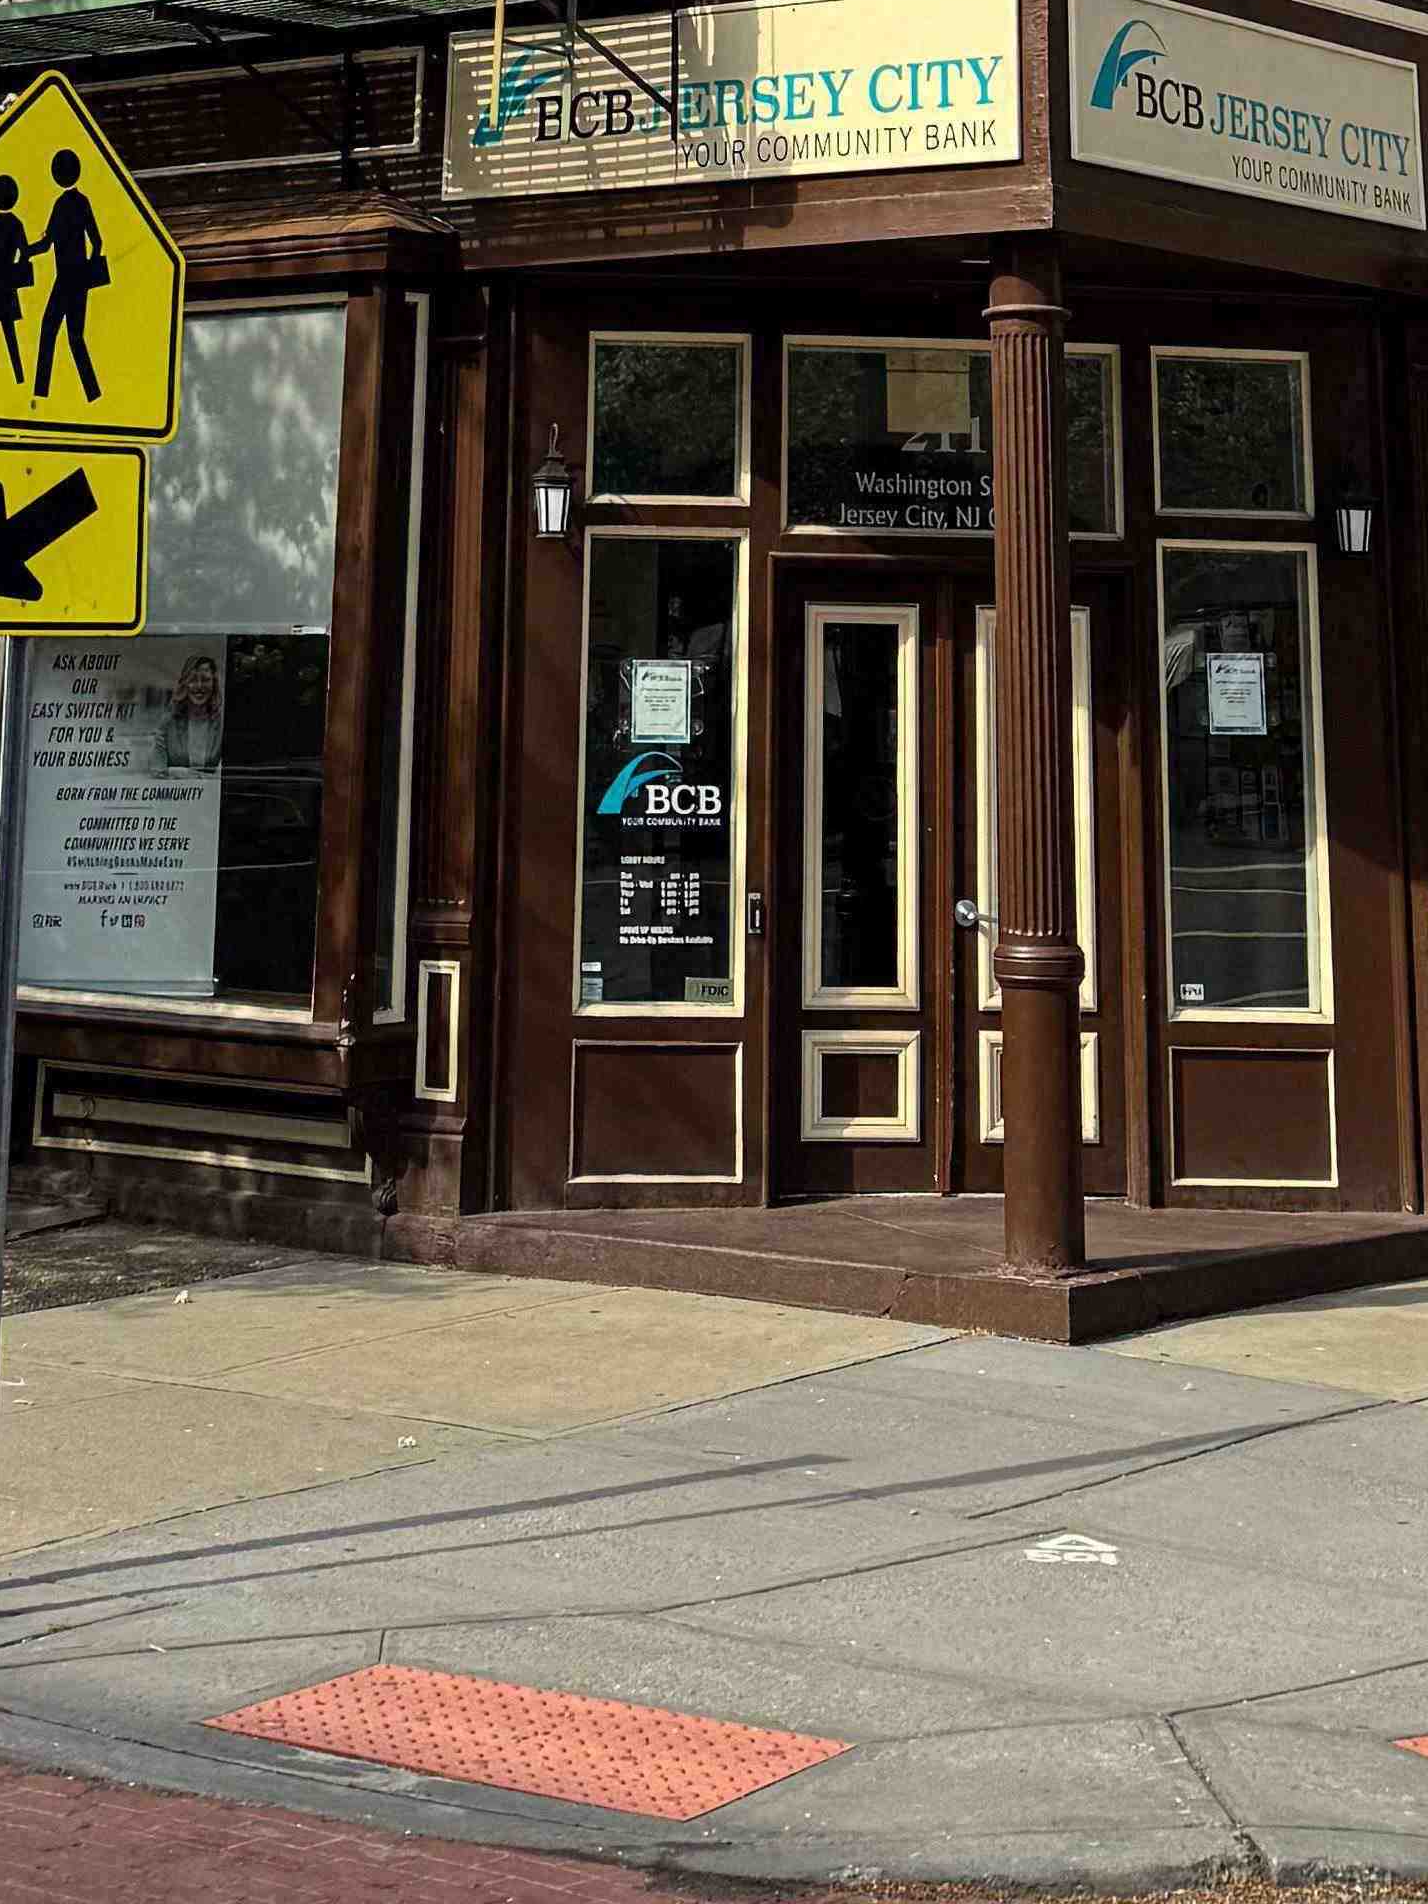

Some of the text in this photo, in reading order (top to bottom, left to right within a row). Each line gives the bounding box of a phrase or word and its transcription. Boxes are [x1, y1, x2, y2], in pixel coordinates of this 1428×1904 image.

[535, 55, 1003, 142] BCB JERSEY CITY
[1134, 72, 1411, 177] BCB JERSEY CITY
[681, 119, 997, 168] YOUR COMMUNITY BANK
[1231, 155, 1412, 216] YOUR COMMUNITY BANK
[855, 471, 993, 500] Washington S
[839, 502, 899, 527] Jersey
[905, 504, 949, 530] City,
[956, 505, 981, 528] NJ
[52, 654, 122, 671] ASK ABOUT
[72, 678, 98, 695] OUR
[31, 702, 137, 719] EASY SWITCH KIT
[48, 727, 115, 743] FOR YOU &
[33, 751, 131, 768] YOUR BUSINESS
[56, 787, 204, 801] BORN FROM THE COMMUNITY
[644, 784, 722, 815] BCB
[79, 817, 178, 831] COMMITTED TO THE
[646, 817, 696, 827] COMMUNITY
[698, 817, 722, 826] BANK
[64, 837, 191, 851] COMMUNITIES WE SERVE
